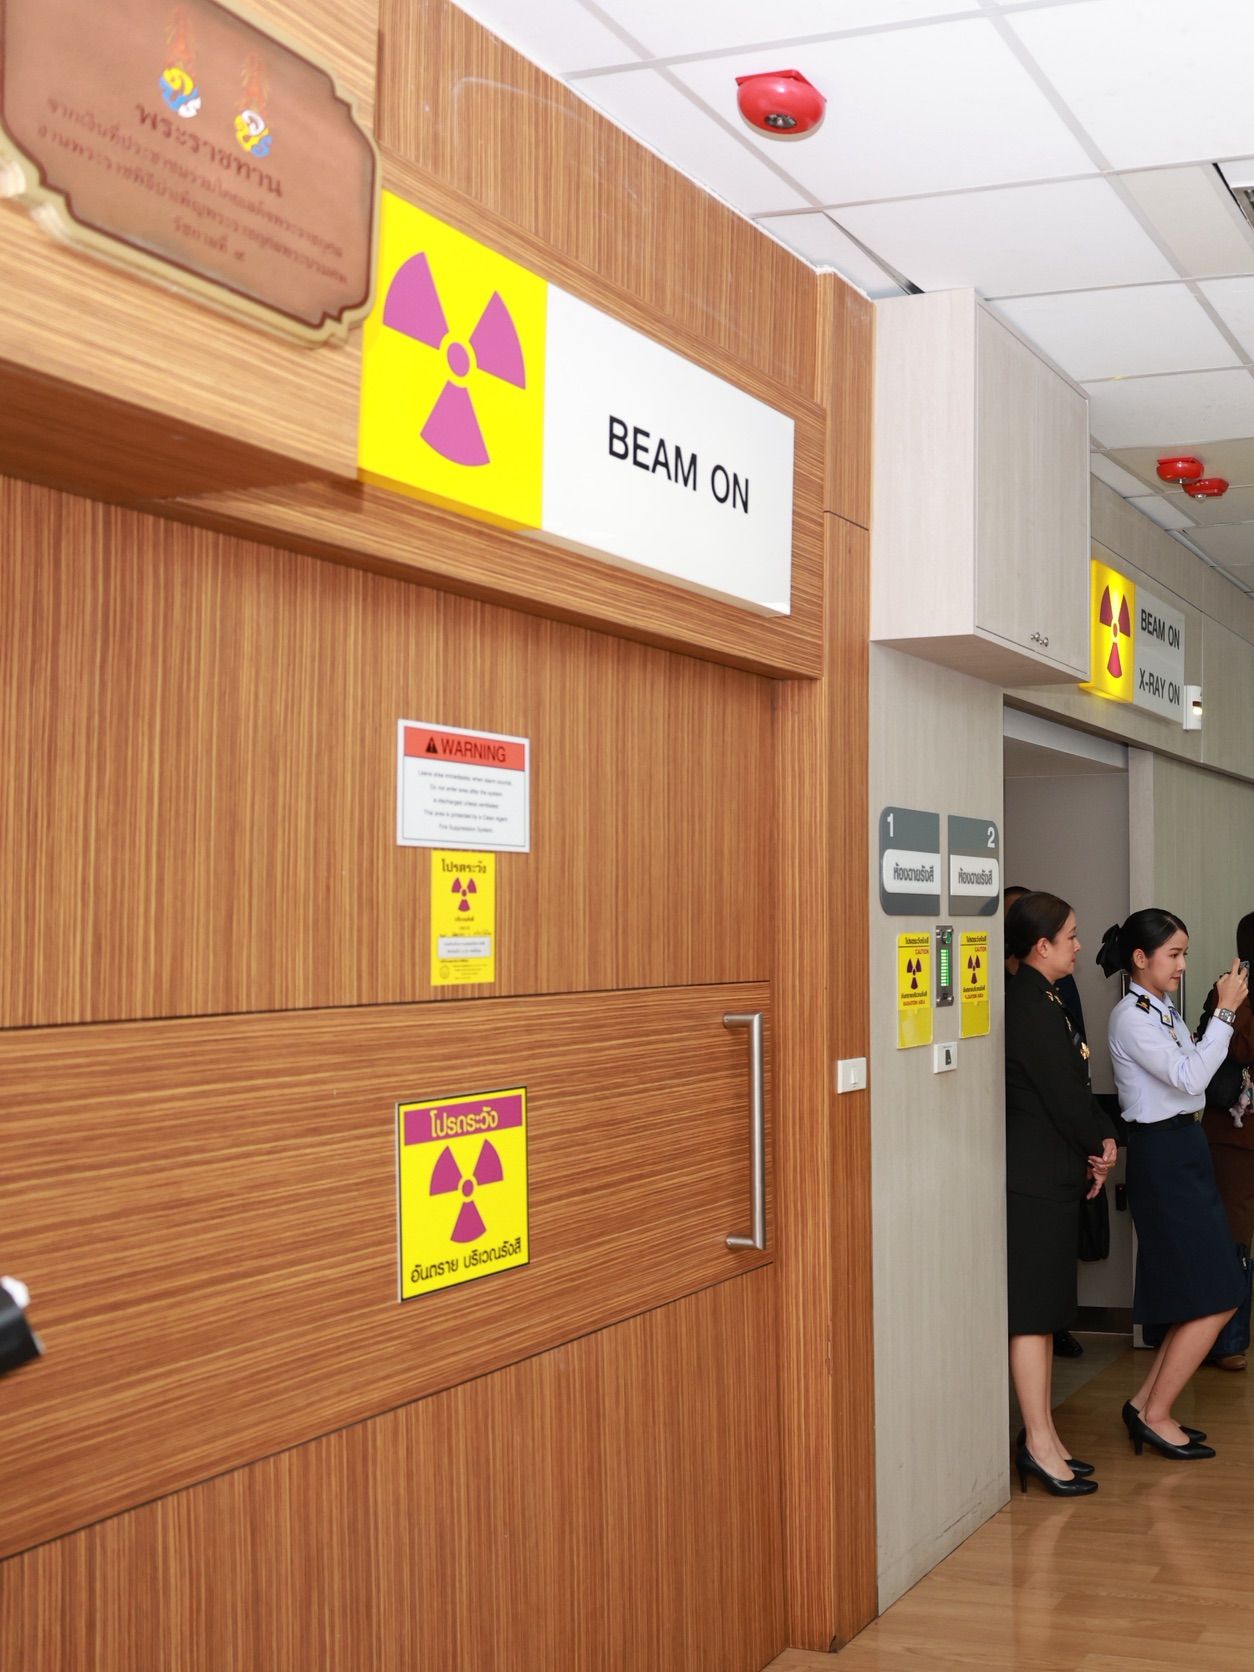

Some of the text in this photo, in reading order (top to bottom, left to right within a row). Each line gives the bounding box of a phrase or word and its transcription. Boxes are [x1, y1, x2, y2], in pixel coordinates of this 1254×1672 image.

[135, 103, 284, 198] พระราชทาน
[608, 414, 750, 515] BEAM ON
[1140, 608, 1180, 651] BEAM ON
[1139, 667, 1180, 706] X-RAY ON
[441, 737, 507, 763] WARNING
[887, 813, 894, 837] 1
[987, 827, 996, 848] 2
[429, 1106, 499, 1138] โปรดระวัง
[410, 1237, 522, 1283] อันตราย บริเวณรังสี
